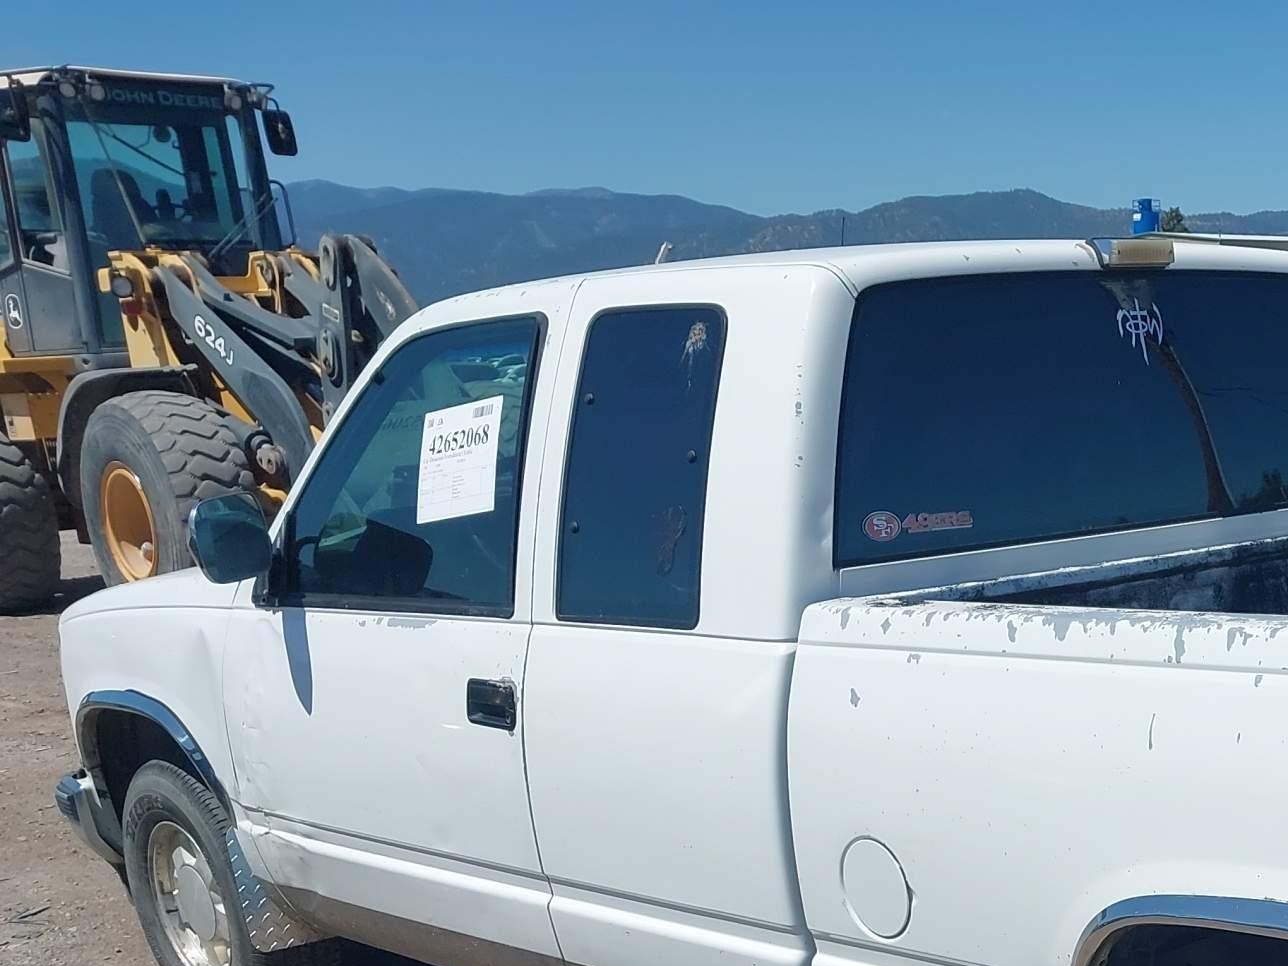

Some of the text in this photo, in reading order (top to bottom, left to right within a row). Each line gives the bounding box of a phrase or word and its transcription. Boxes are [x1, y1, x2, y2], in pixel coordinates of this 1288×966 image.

[105, 86, 224, 110] JOHN DEERE
[194, 315, 234, 366] 624J
[429, 423, 490, 455] 42652068
